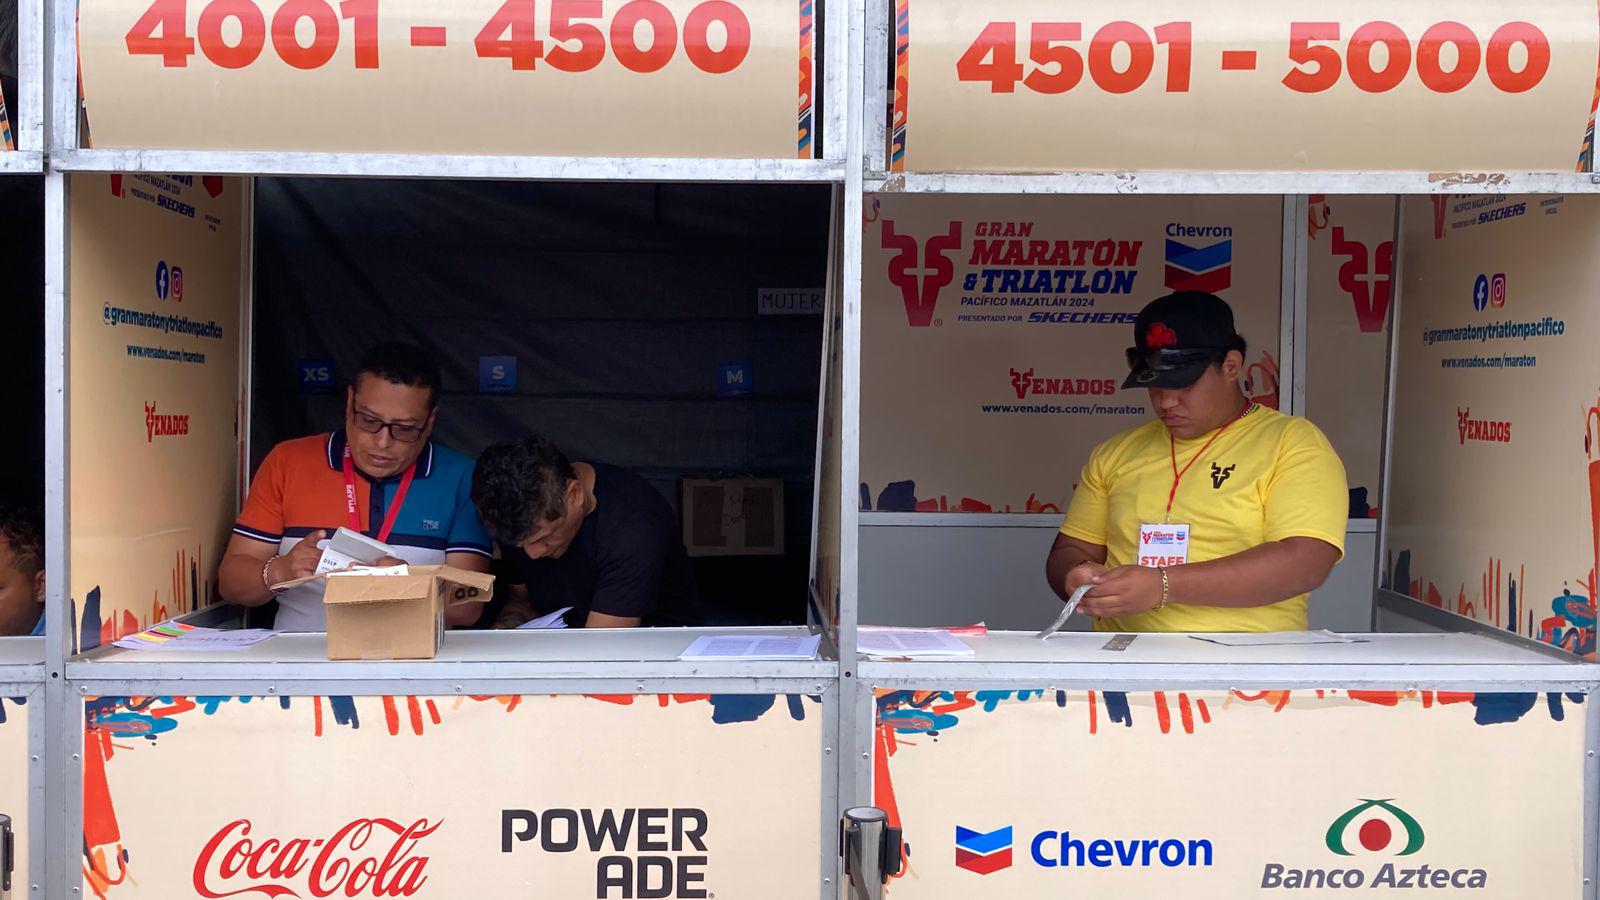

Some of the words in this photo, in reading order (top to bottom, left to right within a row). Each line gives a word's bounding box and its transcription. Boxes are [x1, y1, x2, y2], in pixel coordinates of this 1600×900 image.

[125, 0, 379, 69] 4001
[410, 26, 446, 46] -
[474, 0, 751, 73] 4500
[956, 21, 1192, 94] 4501
[1221, 50, 1257, 70] -
[1281, 21, 1551, 94] 5000
[157, 194, 196, 218] SKECHERS
[1477, 203, 1527, 225] SKECHERS
[975, 222, 1034, 237] GRAN
[1165, 223, 1232, 238] Chevron
[968, 238, 1143, 267] MARATÓN
[961, 295, 1007, 306] PACÍFICO
[1010, 295, 1067, 306] MAZATLÁN
[1069, 298, 1095, 306] 2024
[1028, 312, 1136, 323] SKECHERS
[127, 344, 205, 364] www.venados.com/maraton
[1441, 352, 1536, 369] www.venados.com/maraton
[303, 367, 330, 382] XS
[491, 365, 505, 380] S
[726, 369, 744, 384] M
[1009, 368, 1116, 399] VENADOS
[982, 403, 1145, 415] www.venados.com/maraton
[1457, 407, 1512, 445] VENADOS
[1141, 556, 1184, 567] STAFF
[502, 808, 709, 852] POWER
[193, 817, 445, 899] Coca-Cola
[1030, 830, 1213, 867] Chevron
[596, 856, 708, 899] ADE
[1261, 863, 1365, 888] Banco
[1370, 863, 1488, 888] Azteca
